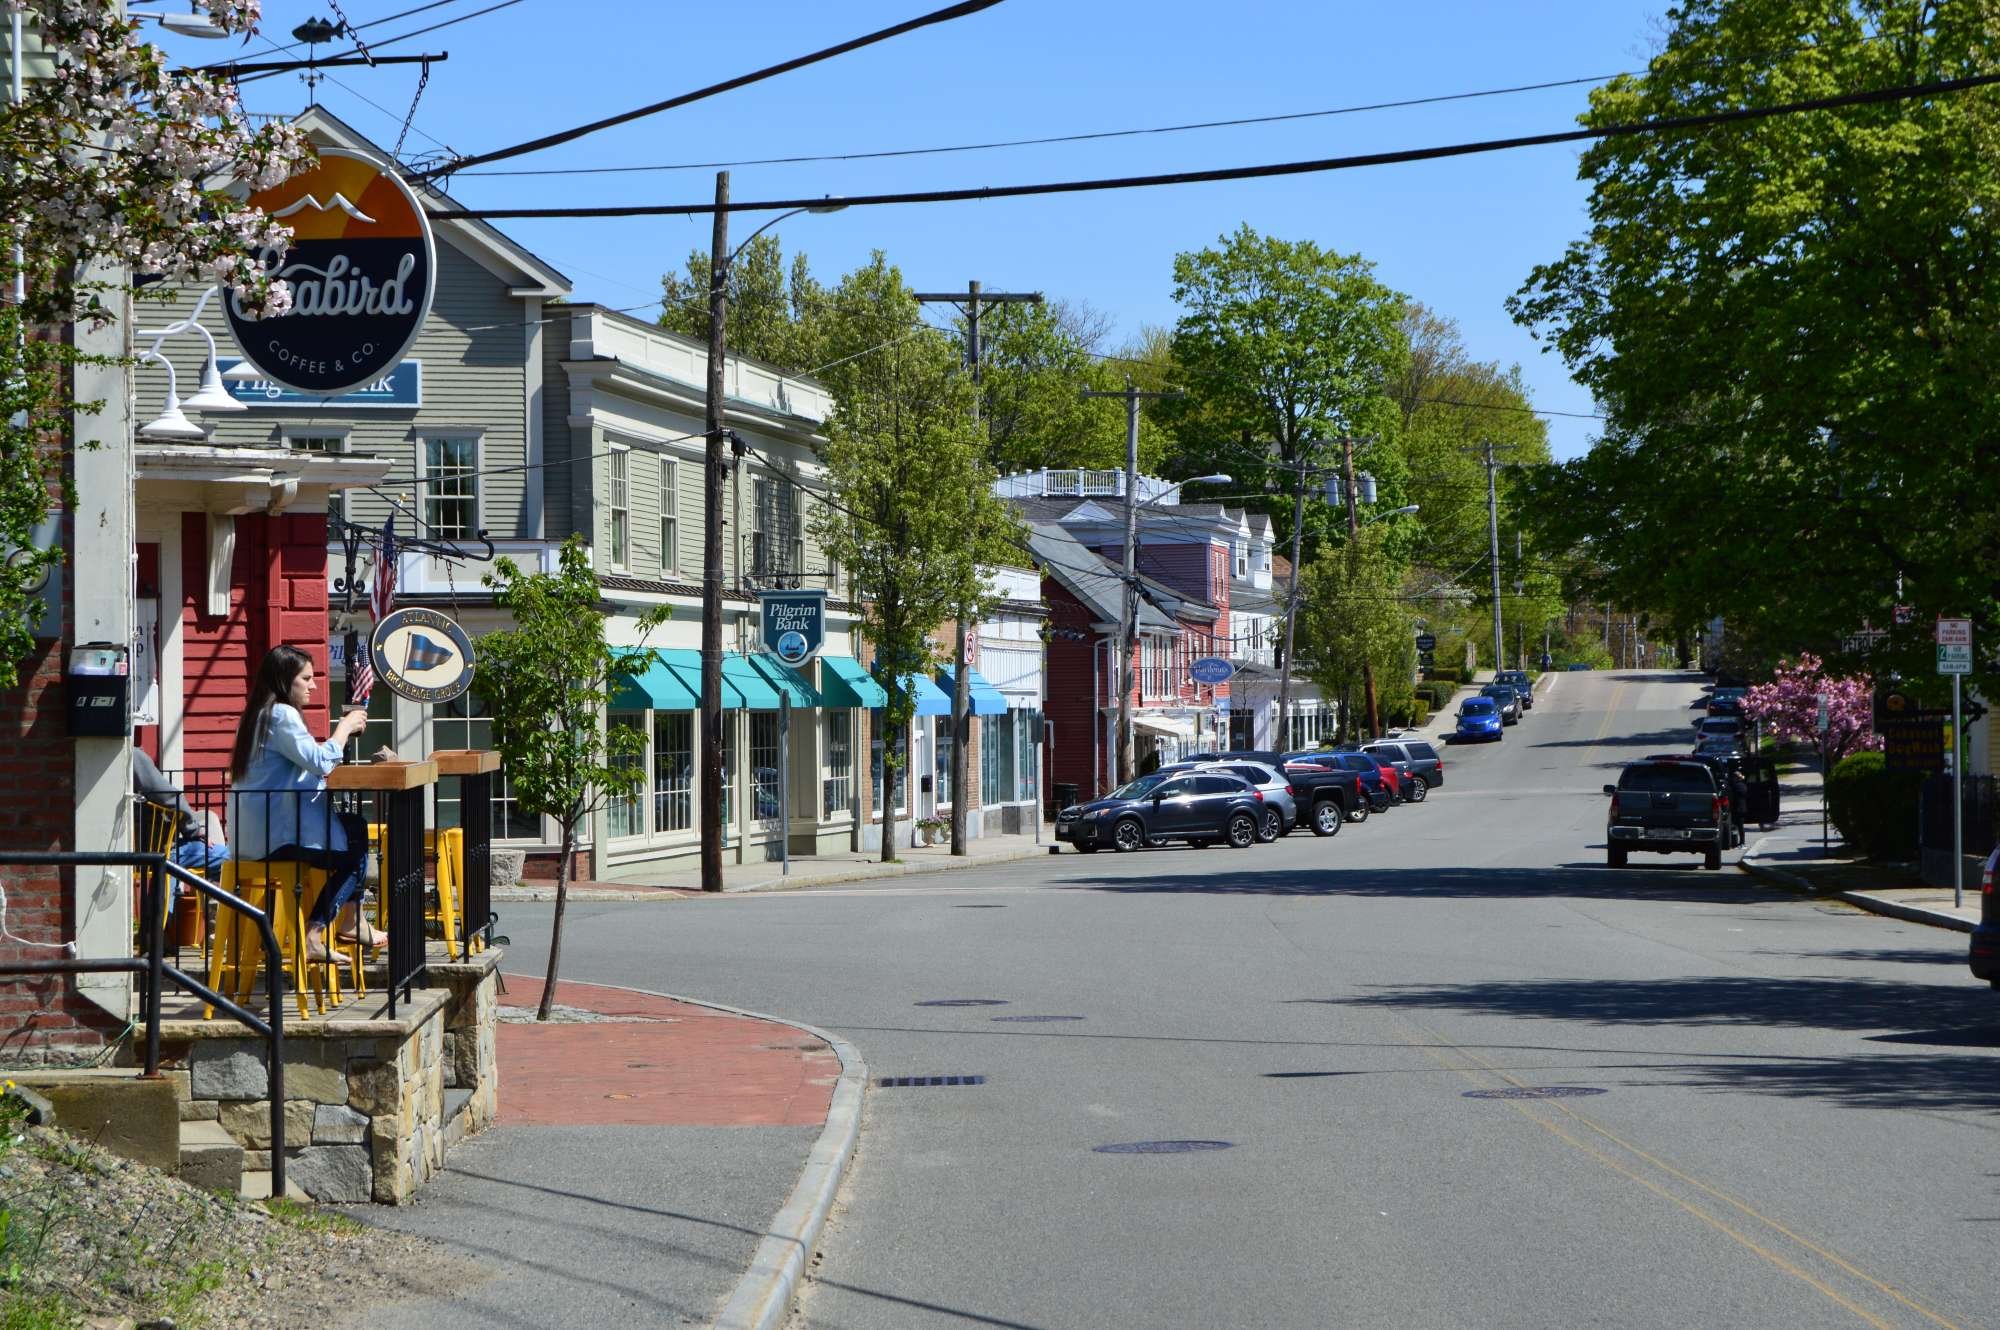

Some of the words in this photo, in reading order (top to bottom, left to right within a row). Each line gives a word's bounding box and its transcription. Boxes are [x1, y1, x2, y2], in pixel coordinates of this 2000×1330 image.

[269, 340, 326, 374] COFFEE
[335, 360, 344, 372] &
[769, 604, 816, 620] Pilgrim
[402, 611, 453, 633] ATLANTIC
[776, 617, 809, 630] Bank
[1940, 646, 1946, 660] 2
[385, 669, 432, 700] BROKERAGE
[434, 682, 461, 700] GROUP
